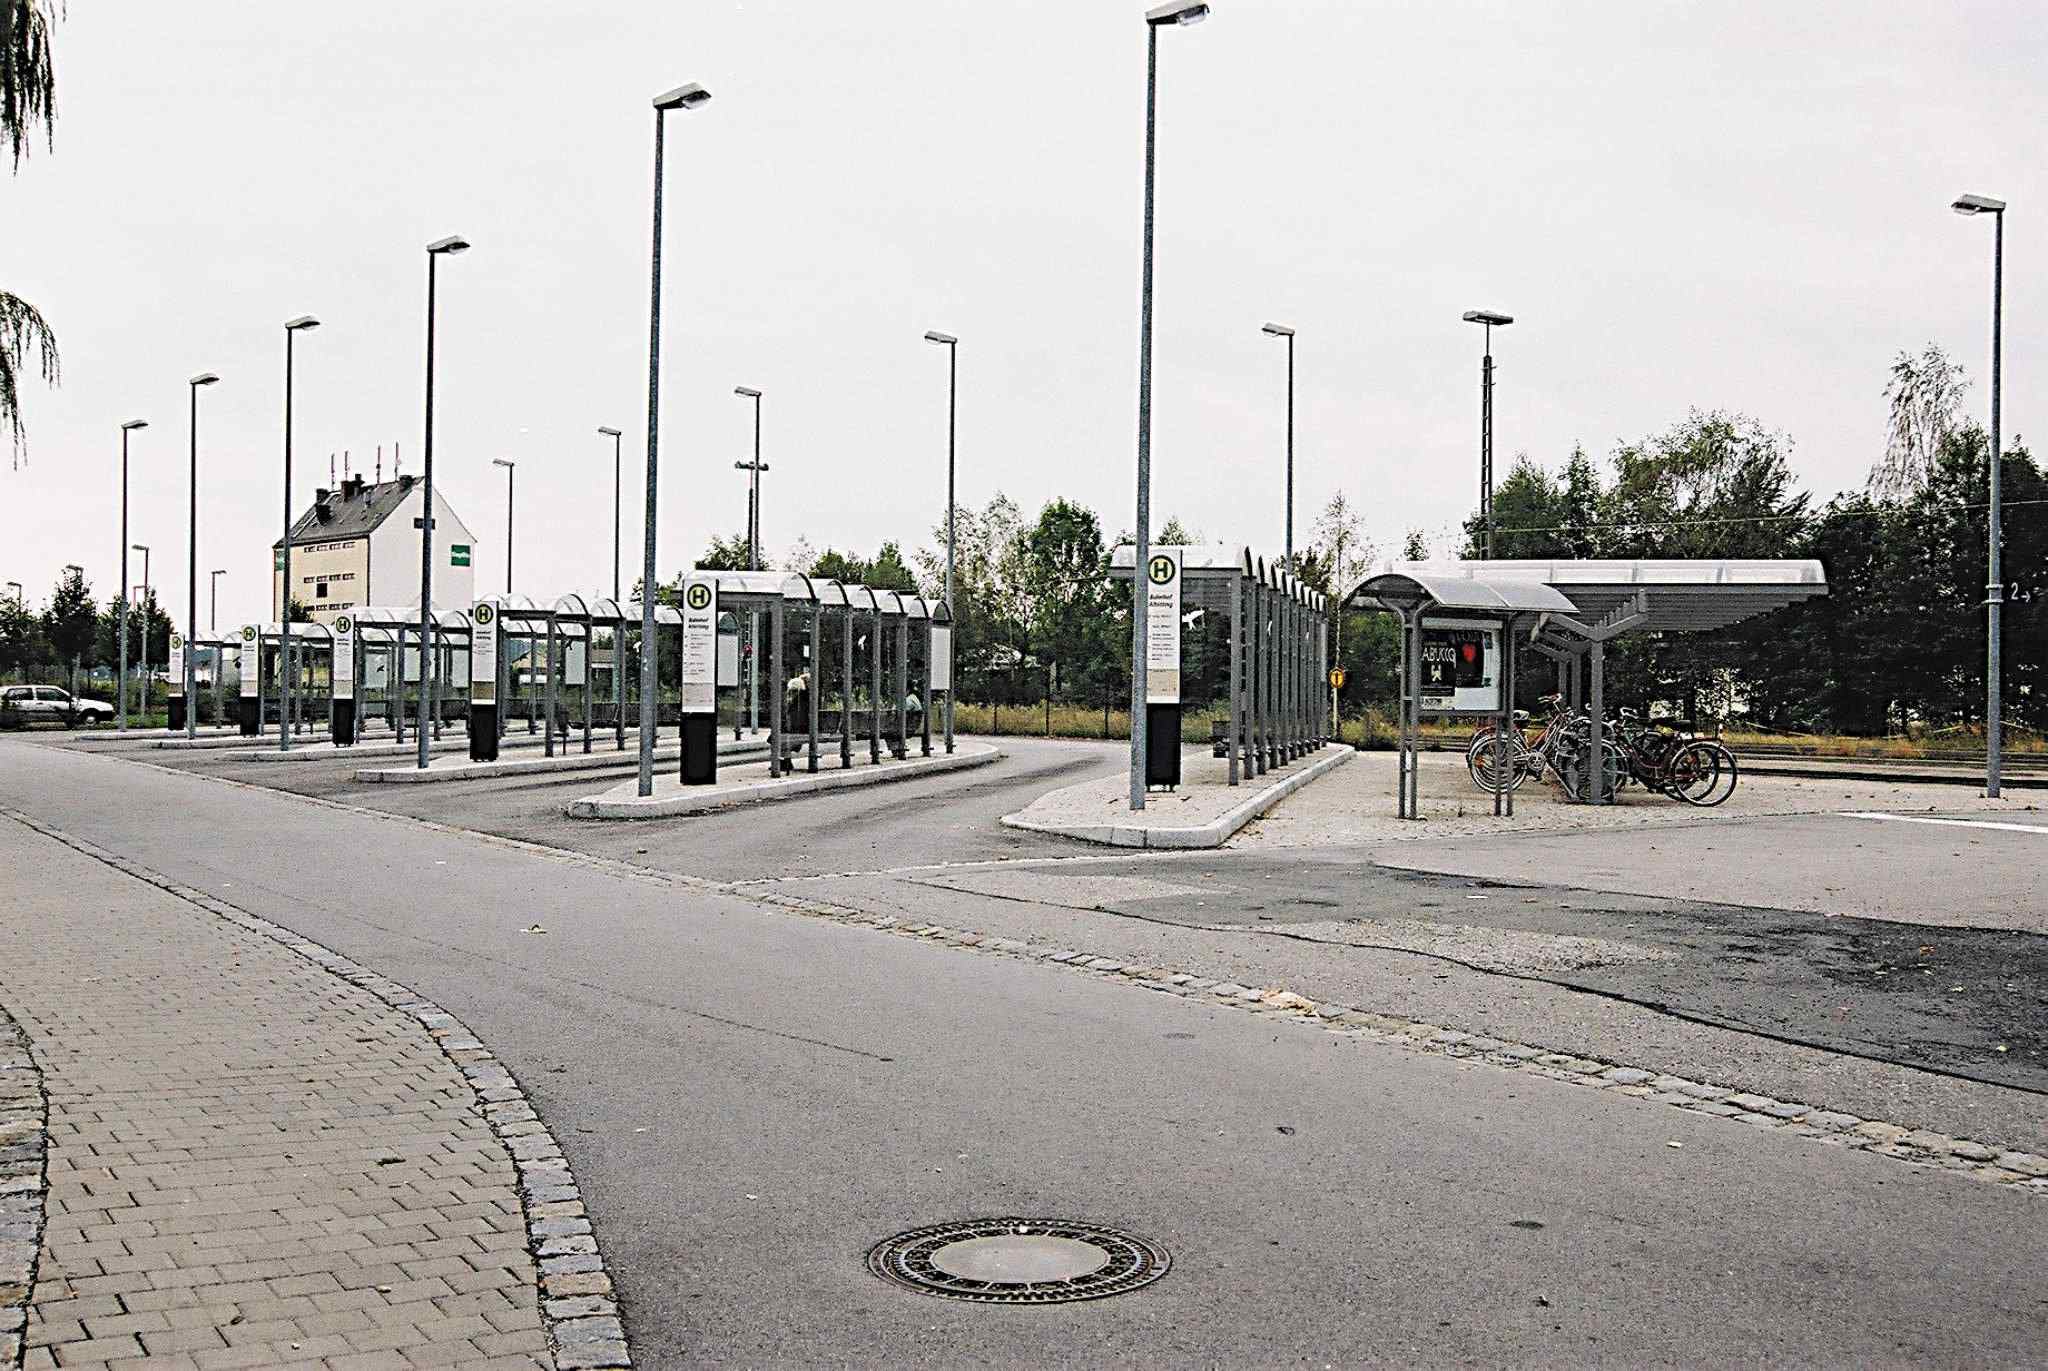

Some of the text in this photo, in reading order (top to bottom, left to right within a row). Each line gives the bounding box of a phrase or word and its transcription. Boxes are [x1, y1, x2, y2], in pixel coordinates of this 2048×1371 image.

[1154, 561, 1168, 578] H
[693, 589, 704, 604] H
[2011, 582, 2019, 600] 2
[479, 608, 489, 620] H
[340, 620, 347, 630] H
